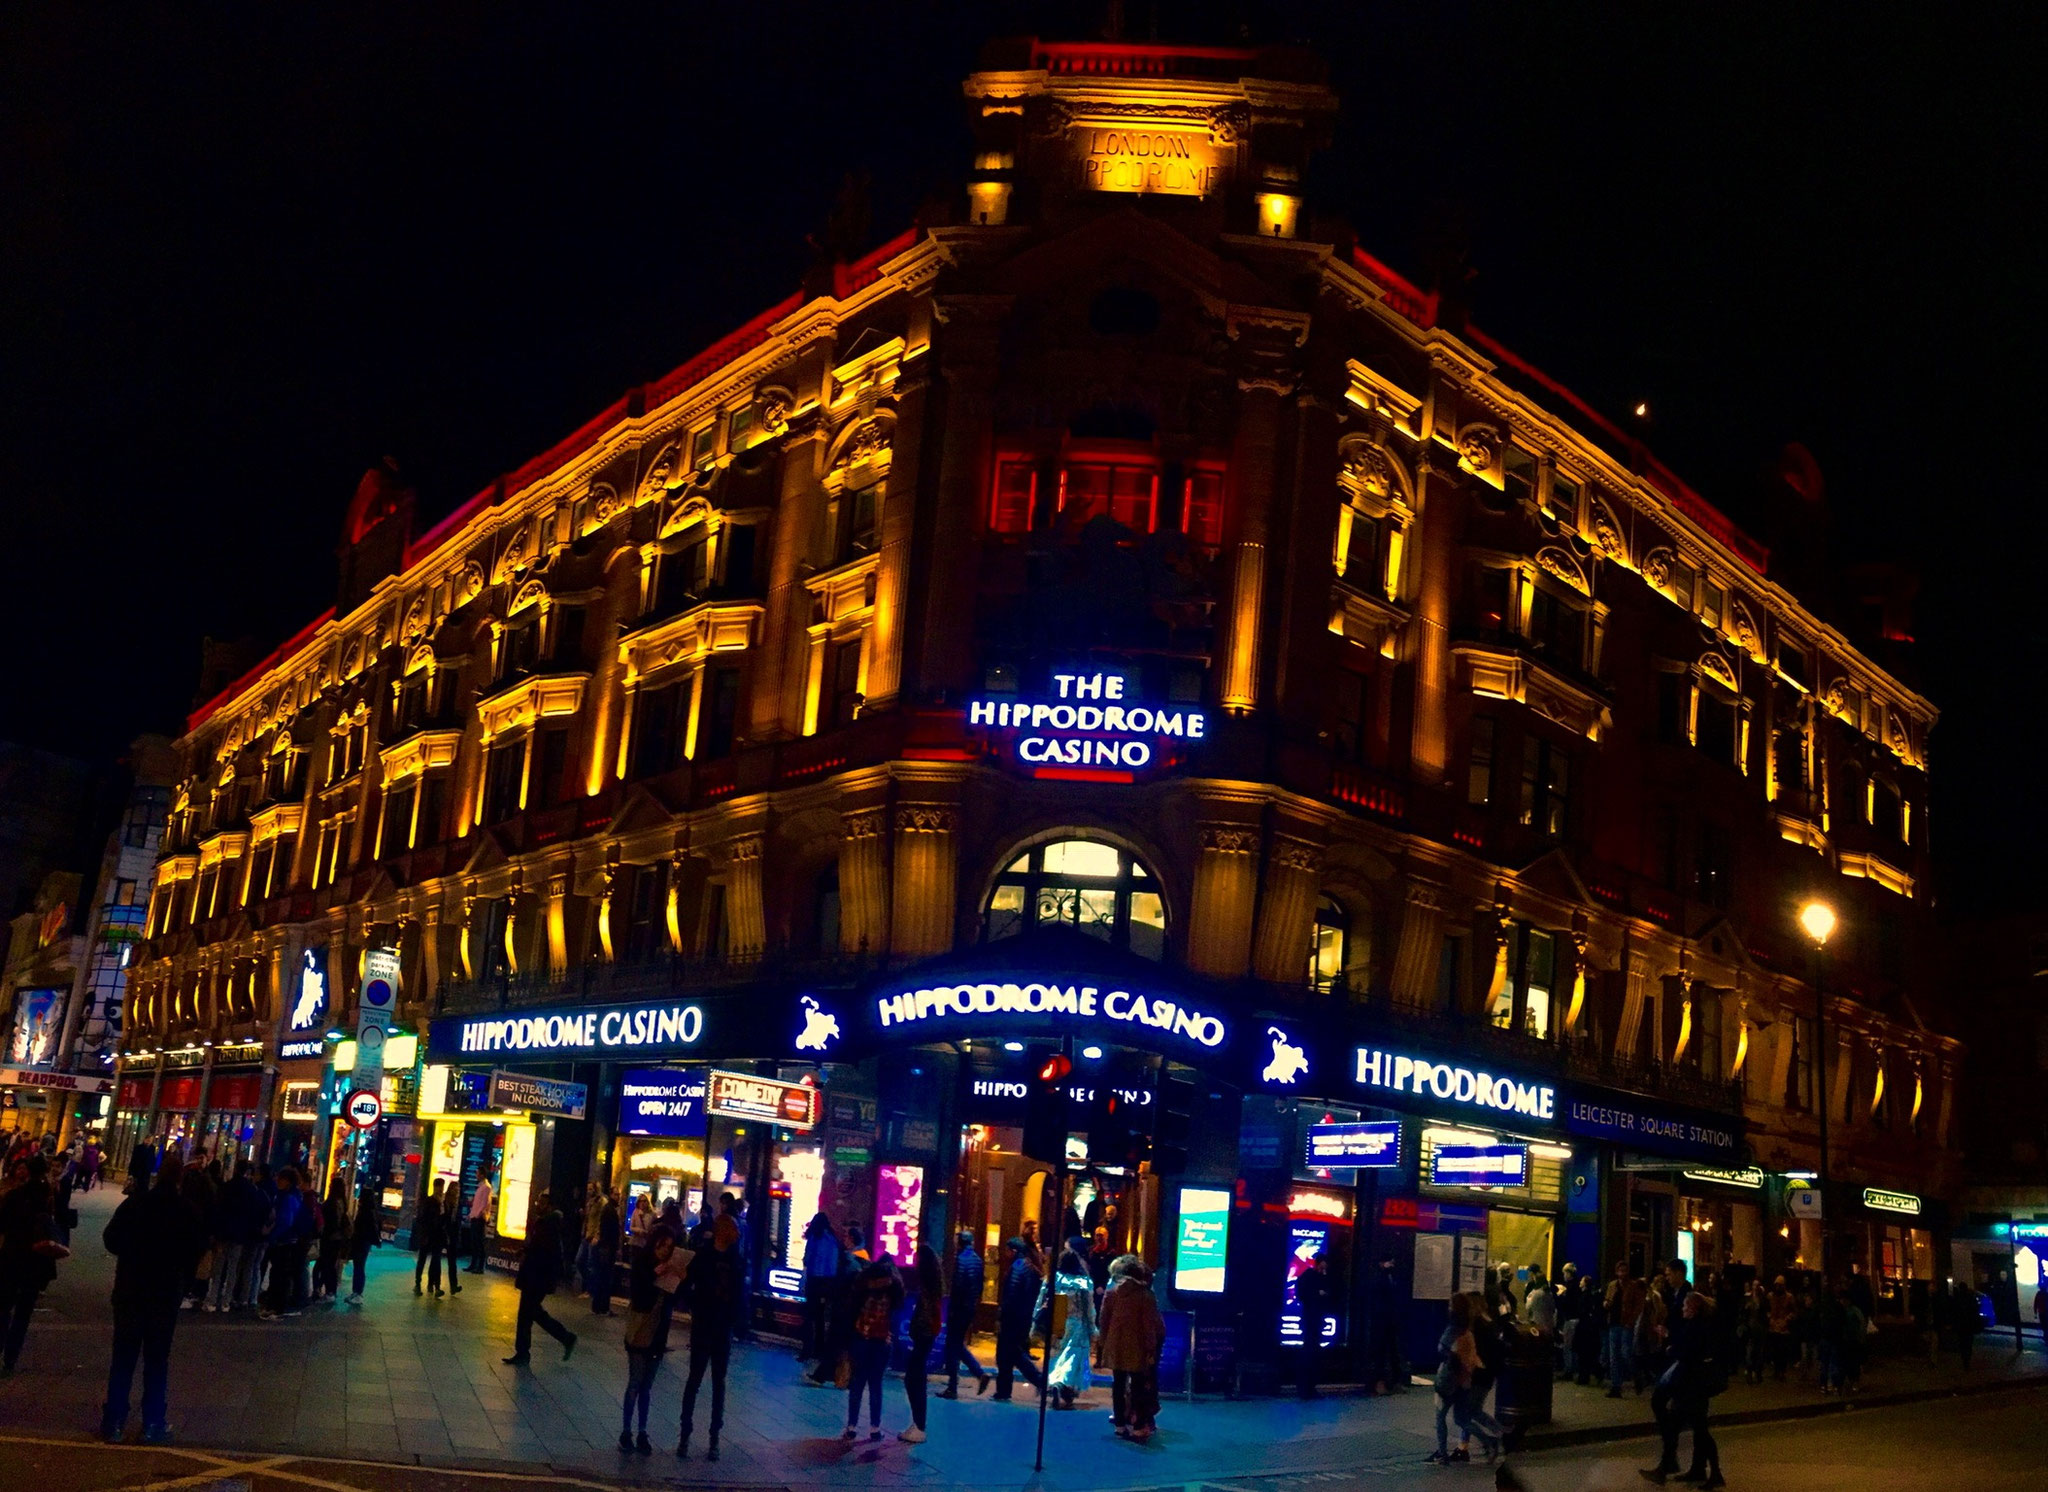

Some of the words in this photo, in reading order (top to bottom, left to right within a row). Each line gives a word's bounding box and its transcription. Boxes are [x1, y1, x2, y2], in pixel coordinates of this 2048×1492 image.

[1090, 132, 1192, 159] LONDON
[1054, 674, 1125, 700] THE
[970, 701, 1204, 738] HIPPODROME
[1019, 737, 1150, 766] CASINO
[369, 969, 393, 980] ZONE
[364, 1016, 385, 1025] ZONE
[878, 983, 1098, 1026] HIPPODROME
[1103, 991, 1225, 1047] CASINO
[461, 1014, 597, 1051] HIPPODROME
[600, 1006, 702, 1046] CASINO
[18, 1071, 78, 1089] DEADPOOL
[498, 1079, 519, 1092] BEST
[520, 1083, 547, 1096] STEAK
[549, 1088, 578, 1099] HOUSE
[721, 1078, 783, 1106] COMEDY
[1356, 1048, 1554, 1119] HIPPODROME
[511, 1093, 521, 1102] IN
[523, 1094, 563, 1109] LONDON
[638, 1101, 667, 1116] OPEN
[667, 1101, 692, 1117] 24/7
[1573, 1103, 1634, 1130] LEICESTER
[1640, 1117, 1685, 1140] SQUARE
[1689, 1126, 1733, 1148] STATION
[487, 1256, 509, 1270] OFFICIAL
